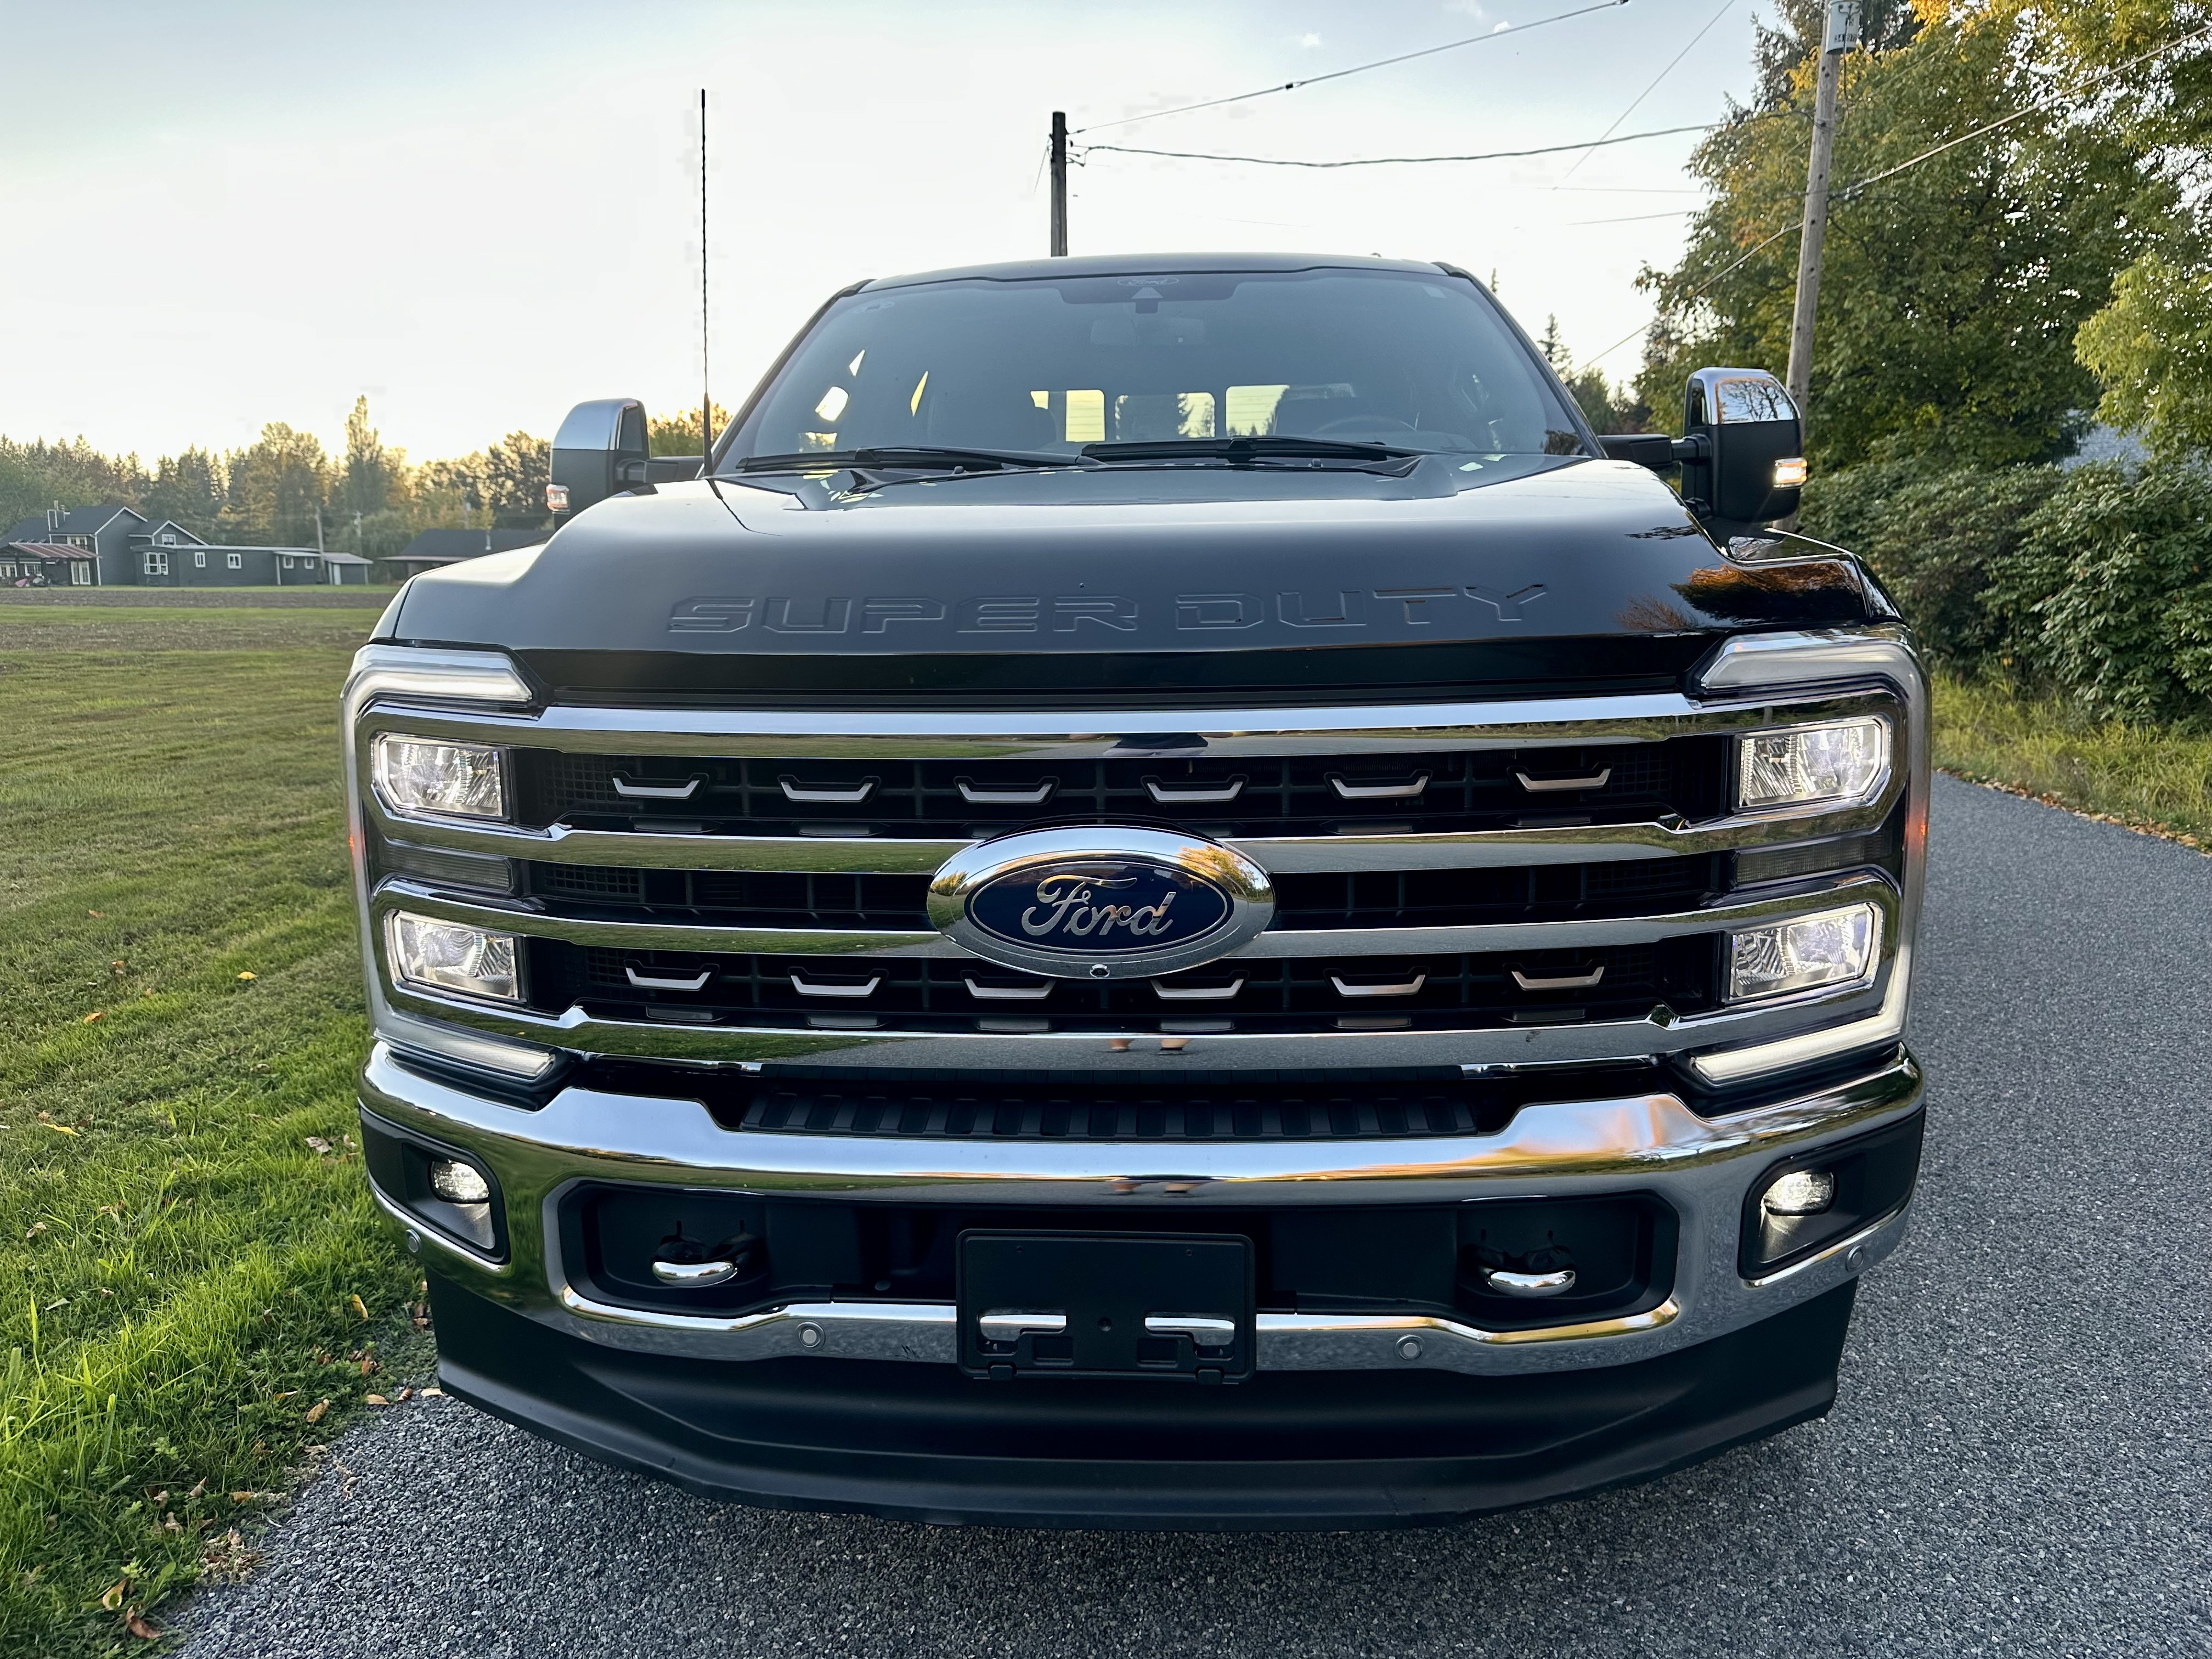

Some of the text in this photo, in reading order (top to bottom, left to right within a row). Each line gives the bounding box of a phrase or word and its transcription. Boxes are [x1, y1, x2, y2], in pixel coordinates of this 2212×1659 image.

[669, 584, 1547, 633] SUPER DUTY
[1021, 874, 1177, 936] Ford
